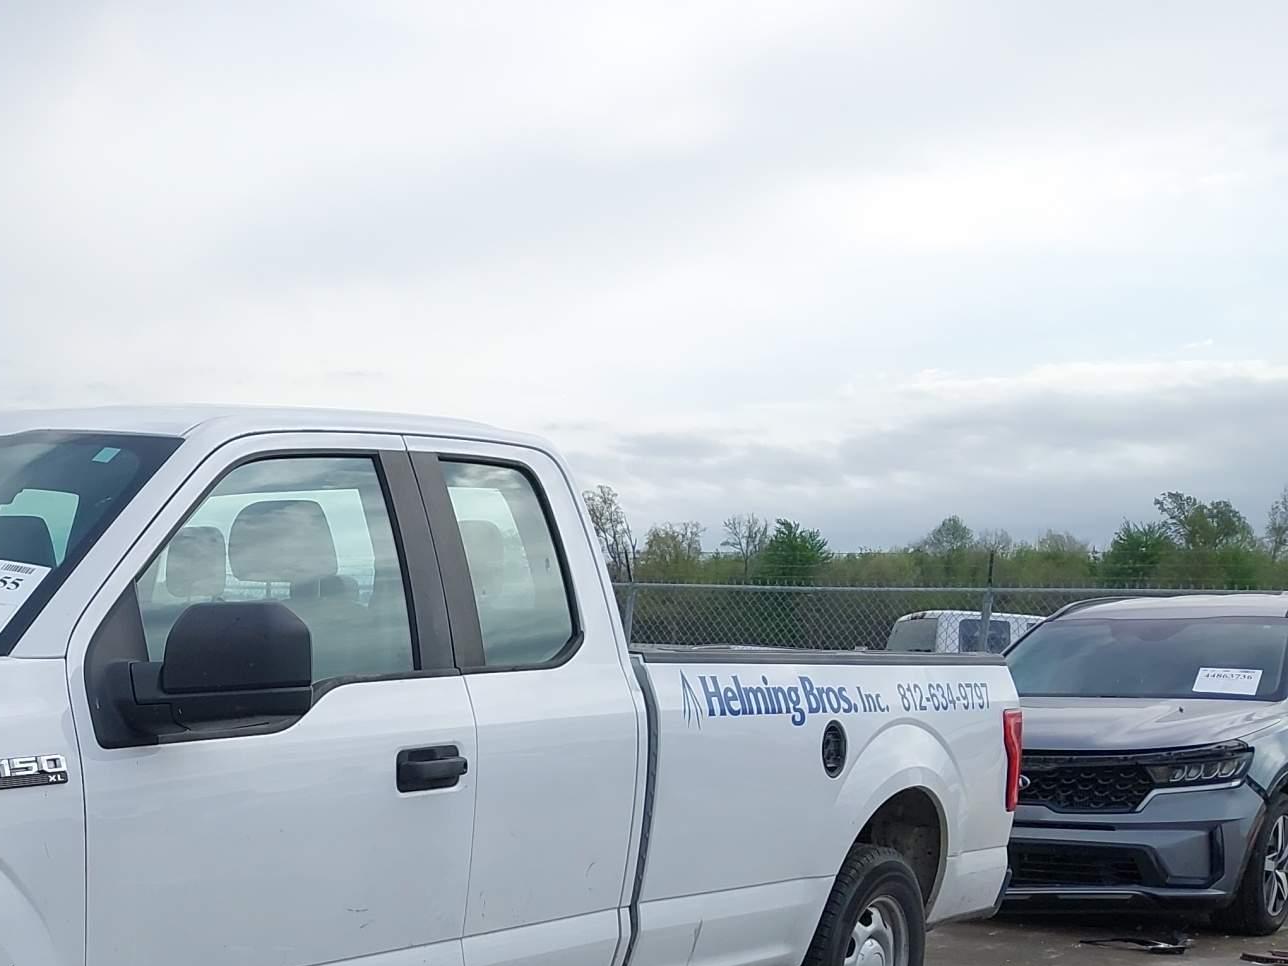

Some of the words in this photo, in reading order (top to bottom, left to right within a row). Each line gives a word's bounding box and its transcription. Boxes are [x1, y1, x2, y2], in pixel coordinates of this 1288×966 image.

[698, 675, 805, 726] Helming
[799, 676, 858, 713] Bros.
[857, 686, 889, 712] Inc.
[897, 683, 990, 711] 812-634-9797
[48, 774, 65, 783] XL
